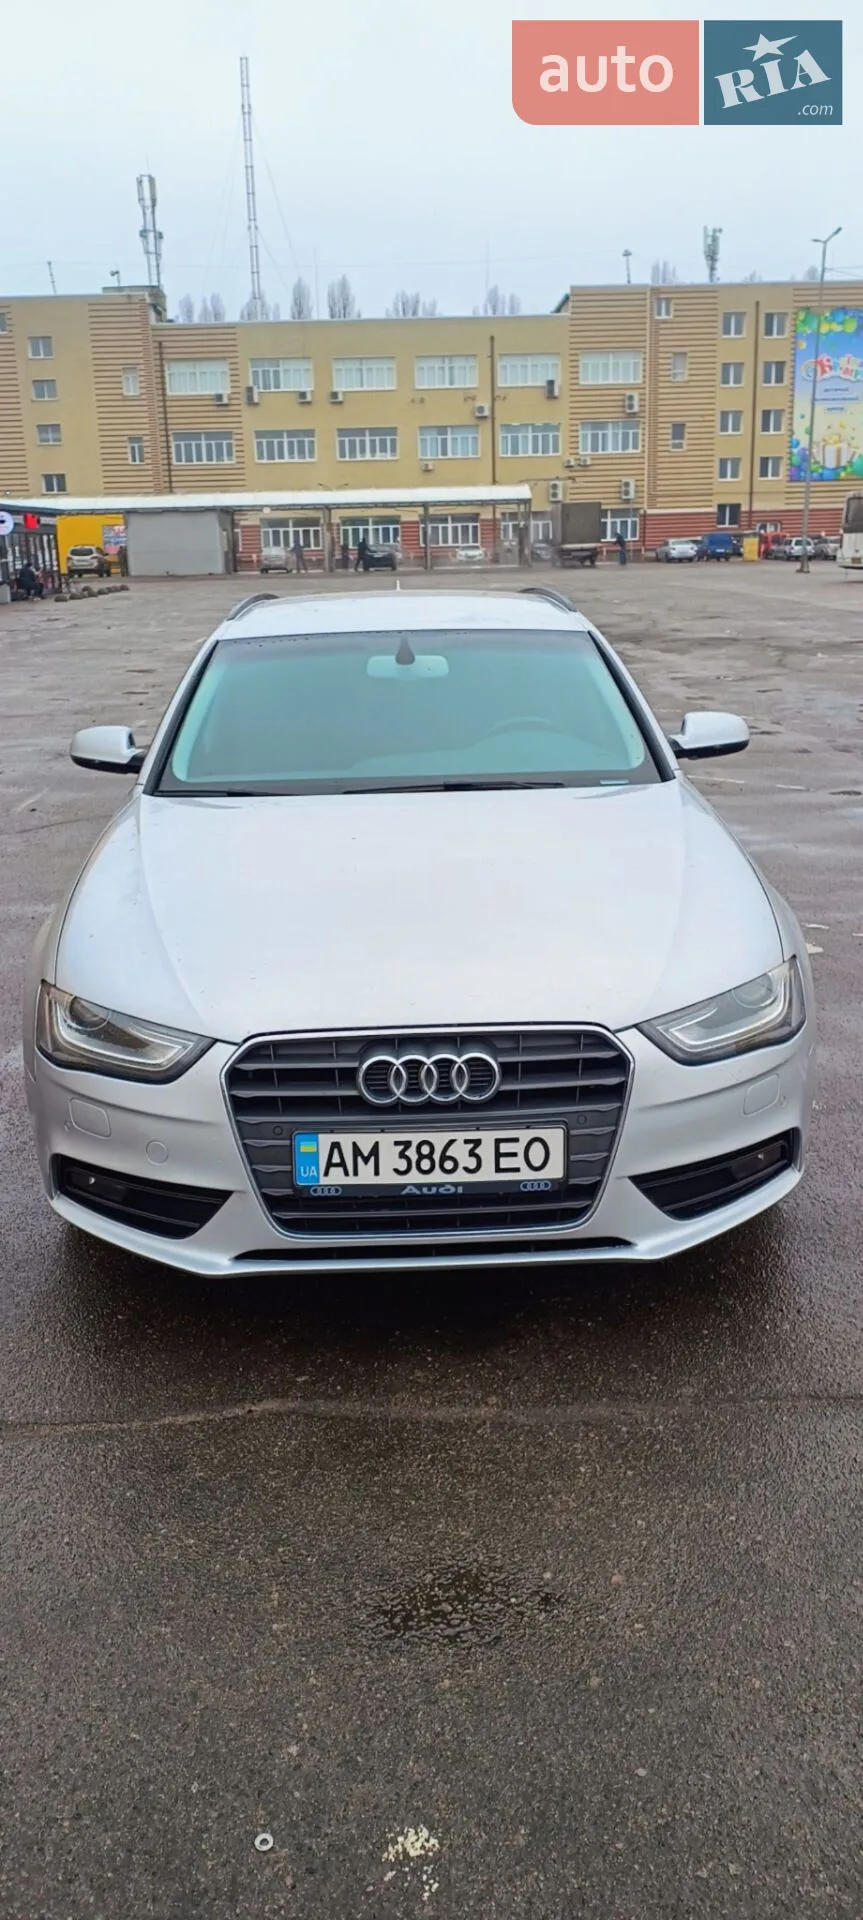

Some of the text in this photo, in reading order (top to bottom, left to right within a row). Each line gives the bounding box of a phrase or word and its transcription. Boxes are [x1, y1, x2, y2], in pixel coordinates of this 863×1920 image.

[323, 1136, 551, 1177] AM 3863 EO
[300, 1166, 318, 1178] UA
[400, 1184, 463, 1195] Audi
